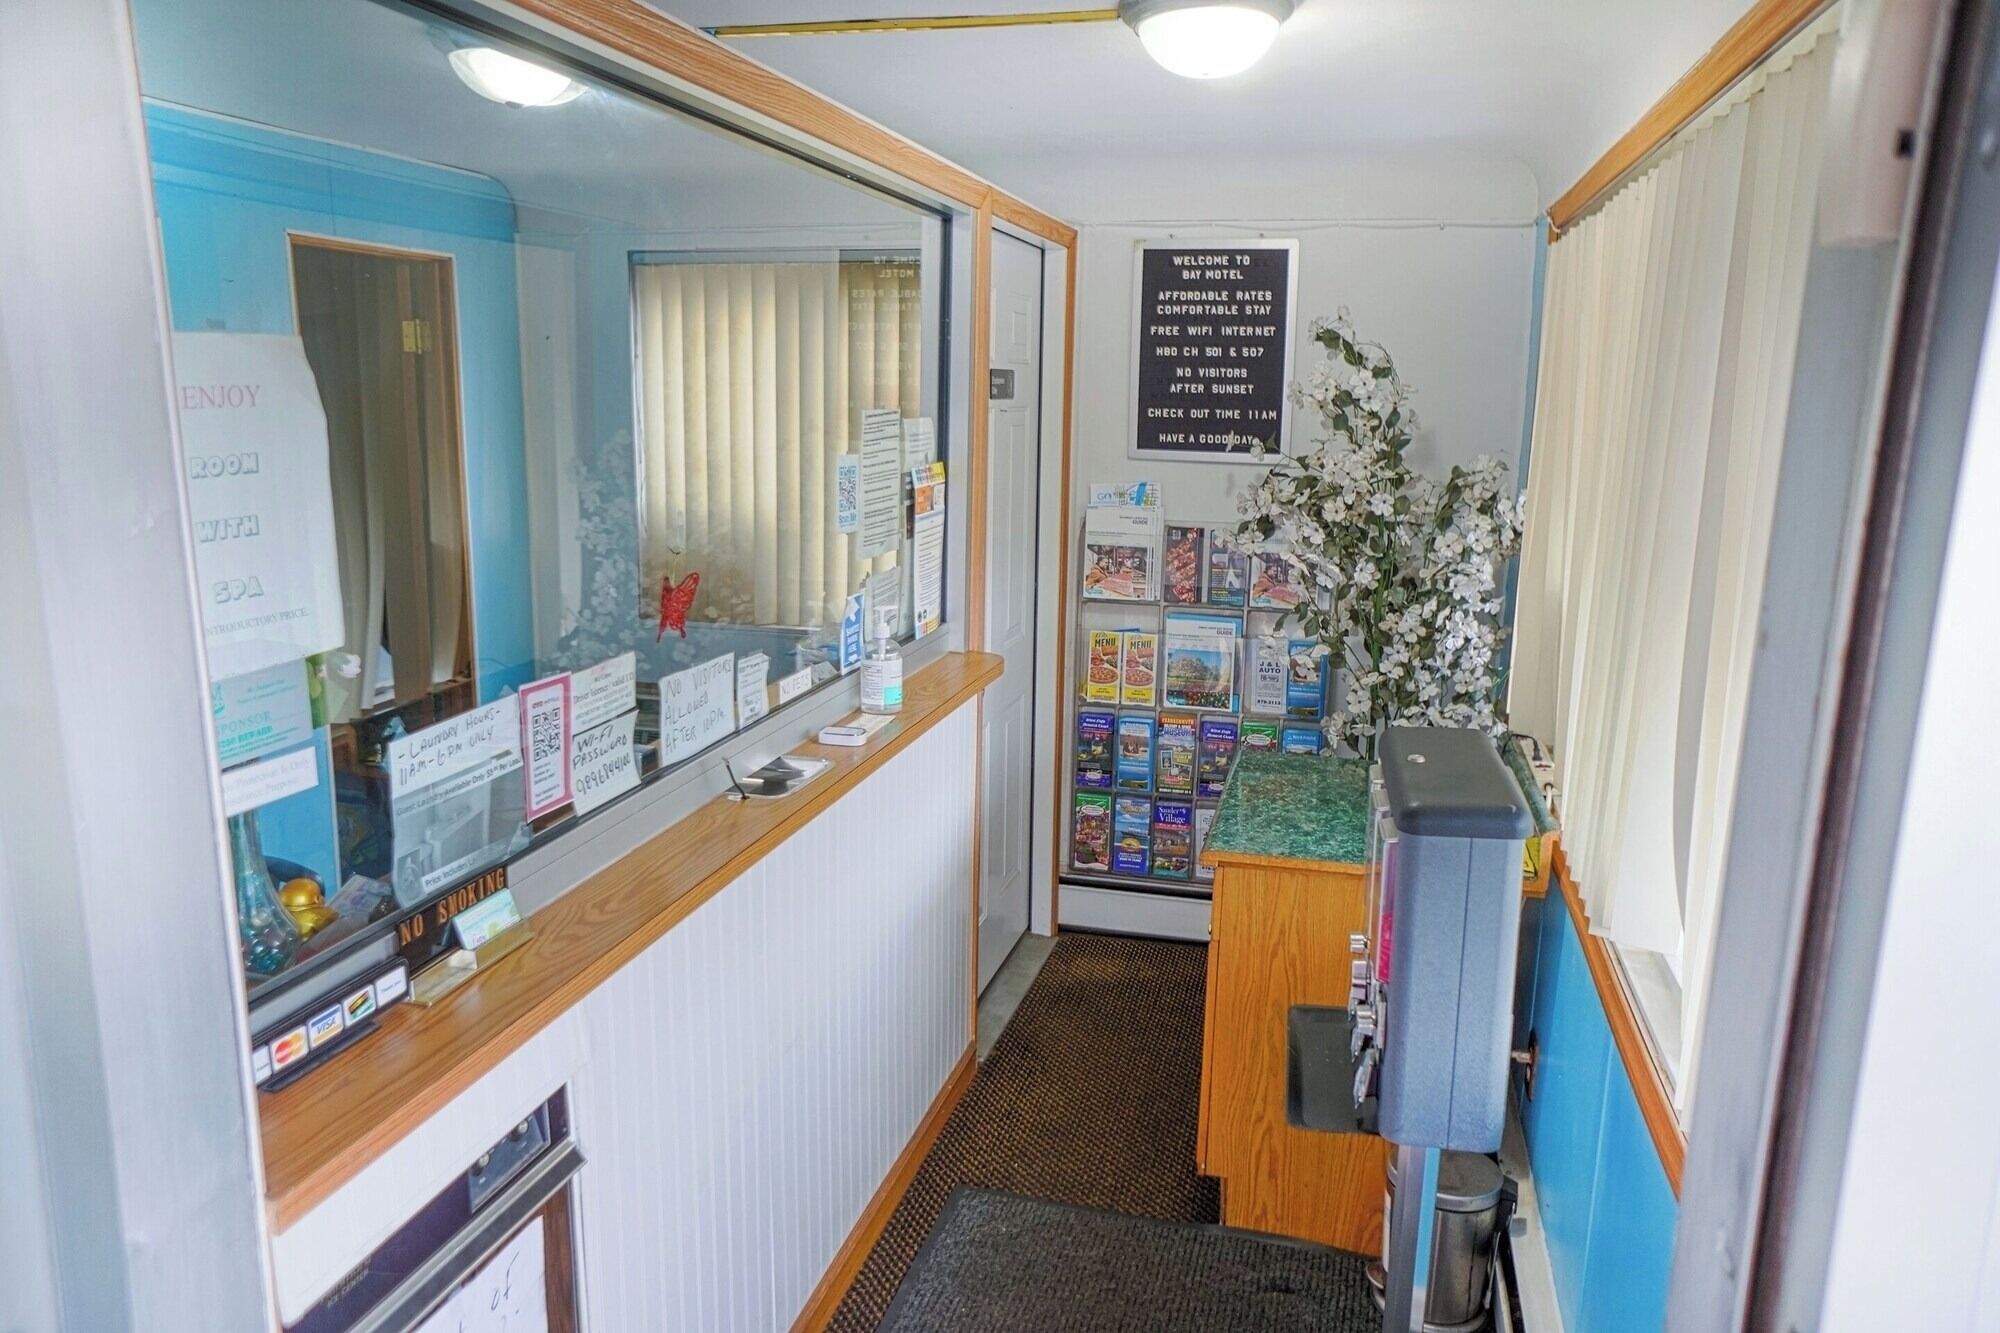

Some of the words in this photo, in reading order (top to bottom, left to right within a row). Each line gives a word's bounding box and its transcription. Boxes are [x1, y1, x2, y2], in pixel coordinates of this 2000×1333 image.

[1173, 255, 1229, 266] WELCOME
[1236, 255, 1251, 266] TO
[1182, 270, 1201, 280] BAY
[1205, 270, 1244, 280] MOTEL
[1158, 291, 1229, 301] AFFORDABLE
[1236, 291, 1273, 301] RATES
[1157, 305, 1239, 315] COMFORTABLE
[1245, 305, 1272, 316] STAY
[1150, 326, 1180, 336] FREE
[1188, 326, 1213, 337] WIFI
[1221, 326, 1277, 337] INTERNET
[1156, 347, 1178, 357] HBO
[1183, 347, 1199, 357] CH
[1205, 347, 1222, 357] 501
[1230, 347, 1237, 357] &
[1242, 347, 1265, 357] 507
[1176, 368, 1192, 378] NO
[1198, 368, 1248, 378] VISITORS
[1170, 384, 1205, 394] AFTER
[1212, 384, 1254, 395] SUNSET
[181, 385, 261, 410] ENJOY
[1148, 408, 1184, 419] CHECK
[1190, 409, 1210, 419] OUT
[1215, 409, 1241, 420] TIME
[1159, 433, 1185, 444] HAVE
[1189, 433, 1195, 444] A
[1199, 434, 1229, 445] GOOD
[190, 452, 260, 480] ROOM
[195, 514, 261, 543] WITH
[213, 576, 265, 604] SPA
[206, 614, 277, 637] NTRODUCTORY
[280, 607, 310, 623] PRICE
[1094, 638, 1116, 648] MENU
[1130, 640, 1152, 650] MENU
[666, 678, 682, 700] NO
[692, 658, 732, 691] VISITORS
[665, 691, 709, 726] ALLOWED
[409, 724, 459, 759] LAUNDRY
[469, 725, 494, 748] ONLY
[665, 726, 697, 753] AFTER
[573, 733, 628, 771] PASSWORD
[1160, 813, 1186, 824] Village
[425, 876, 443, 888] Price
[400, 913, 424, 946] NO
[437, 867, 505, 925] SMOKING
[317, 1017, 336, 1035] VISA
